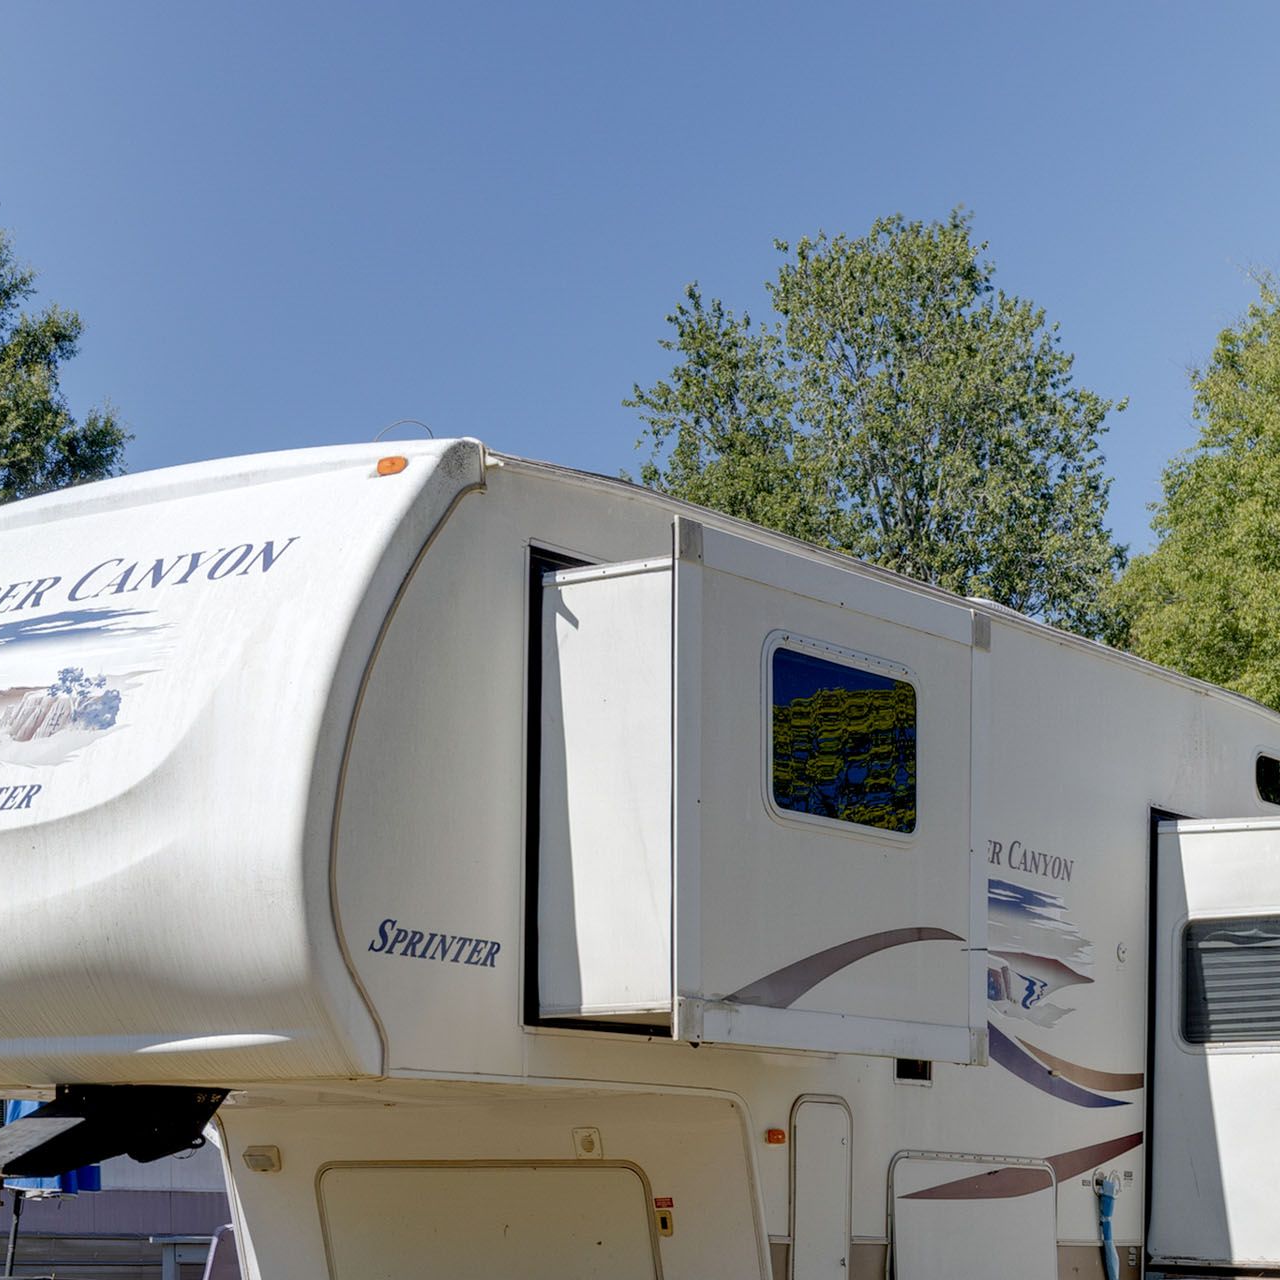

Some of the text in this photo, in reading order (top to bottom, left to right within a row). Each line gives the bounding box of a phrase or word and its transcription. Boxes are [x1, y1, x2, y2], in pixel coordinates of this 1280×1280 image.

[67, 536, 301, 602] CANYON
[1008, 840, 1074, 882] CANYON
[368, 918, 502, 968] SPRINTER
